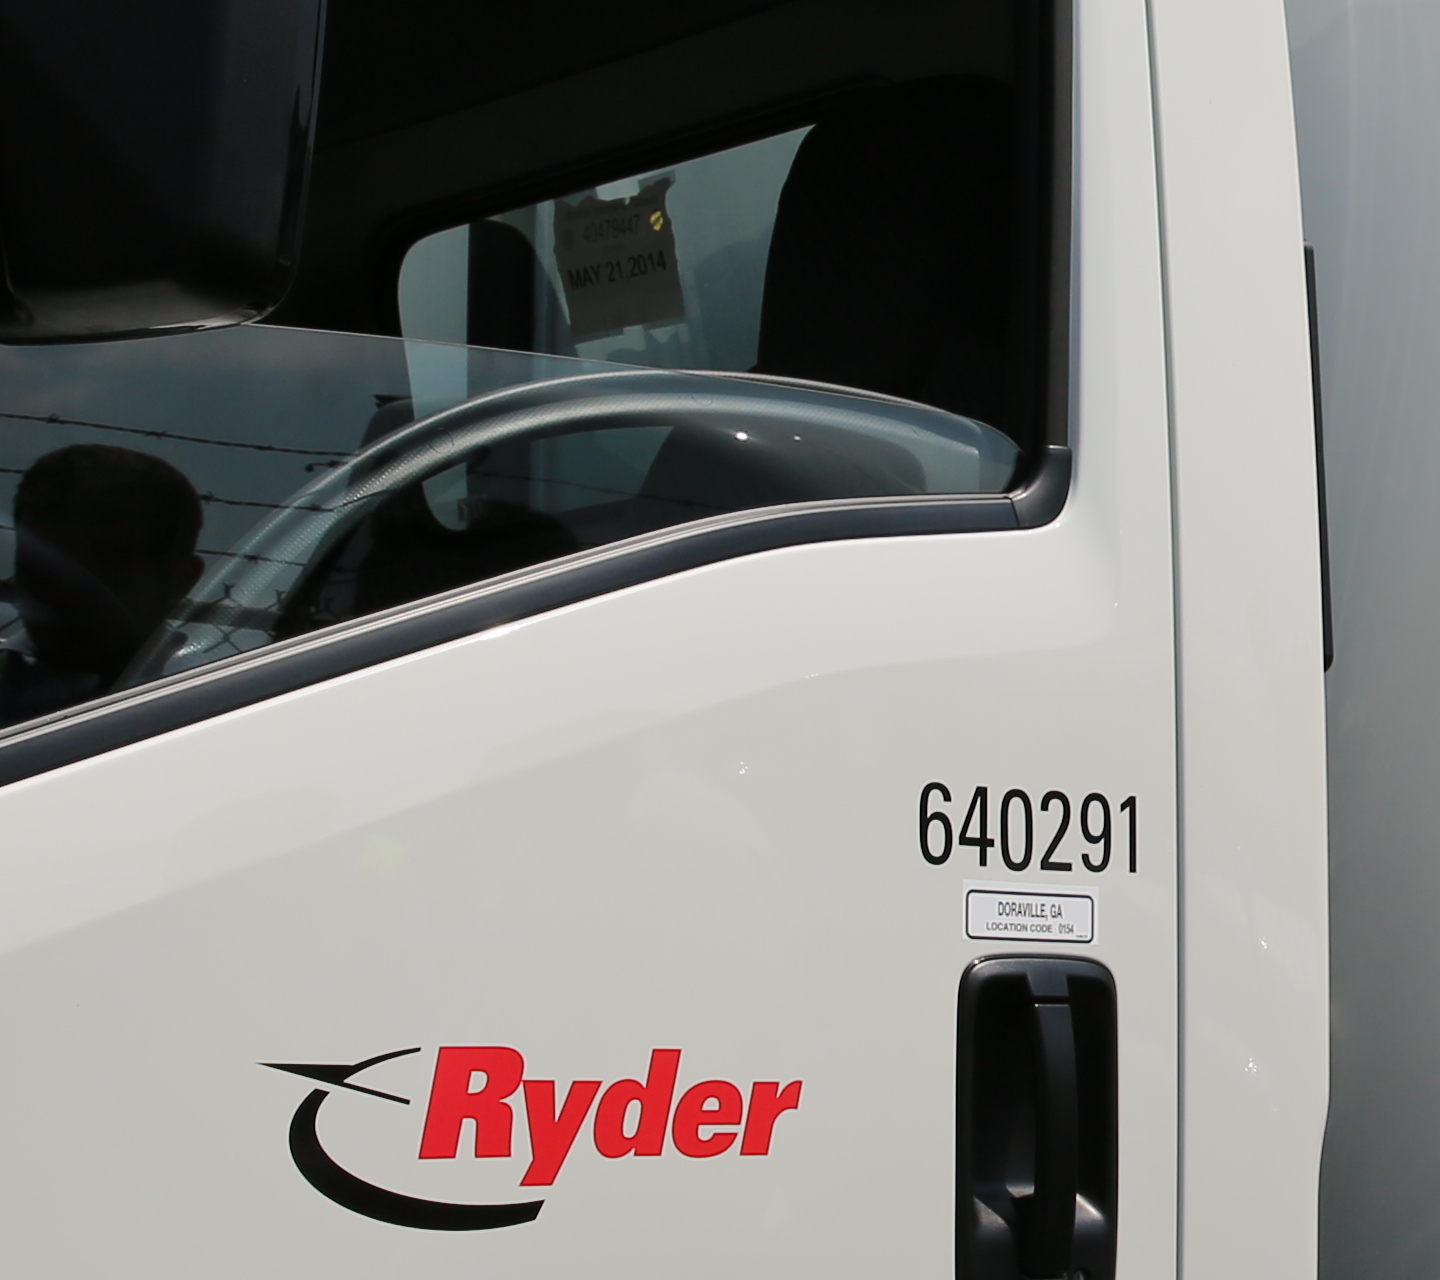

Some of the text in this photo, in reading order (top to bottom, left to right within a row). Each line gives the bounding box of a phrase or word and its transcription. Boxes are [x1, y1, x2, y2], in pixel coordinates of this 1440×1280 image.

[568, 262, 602, 291] MAY
[918, 782, 1138, 873] 640291
[998, 901, 1063, 921] DORAVILLE, GA
[986, 922, 1028, 932] LOCATION
[1030, 924, 1053, 933] CODE
[418, 1046, 803, 1186] Ryder
